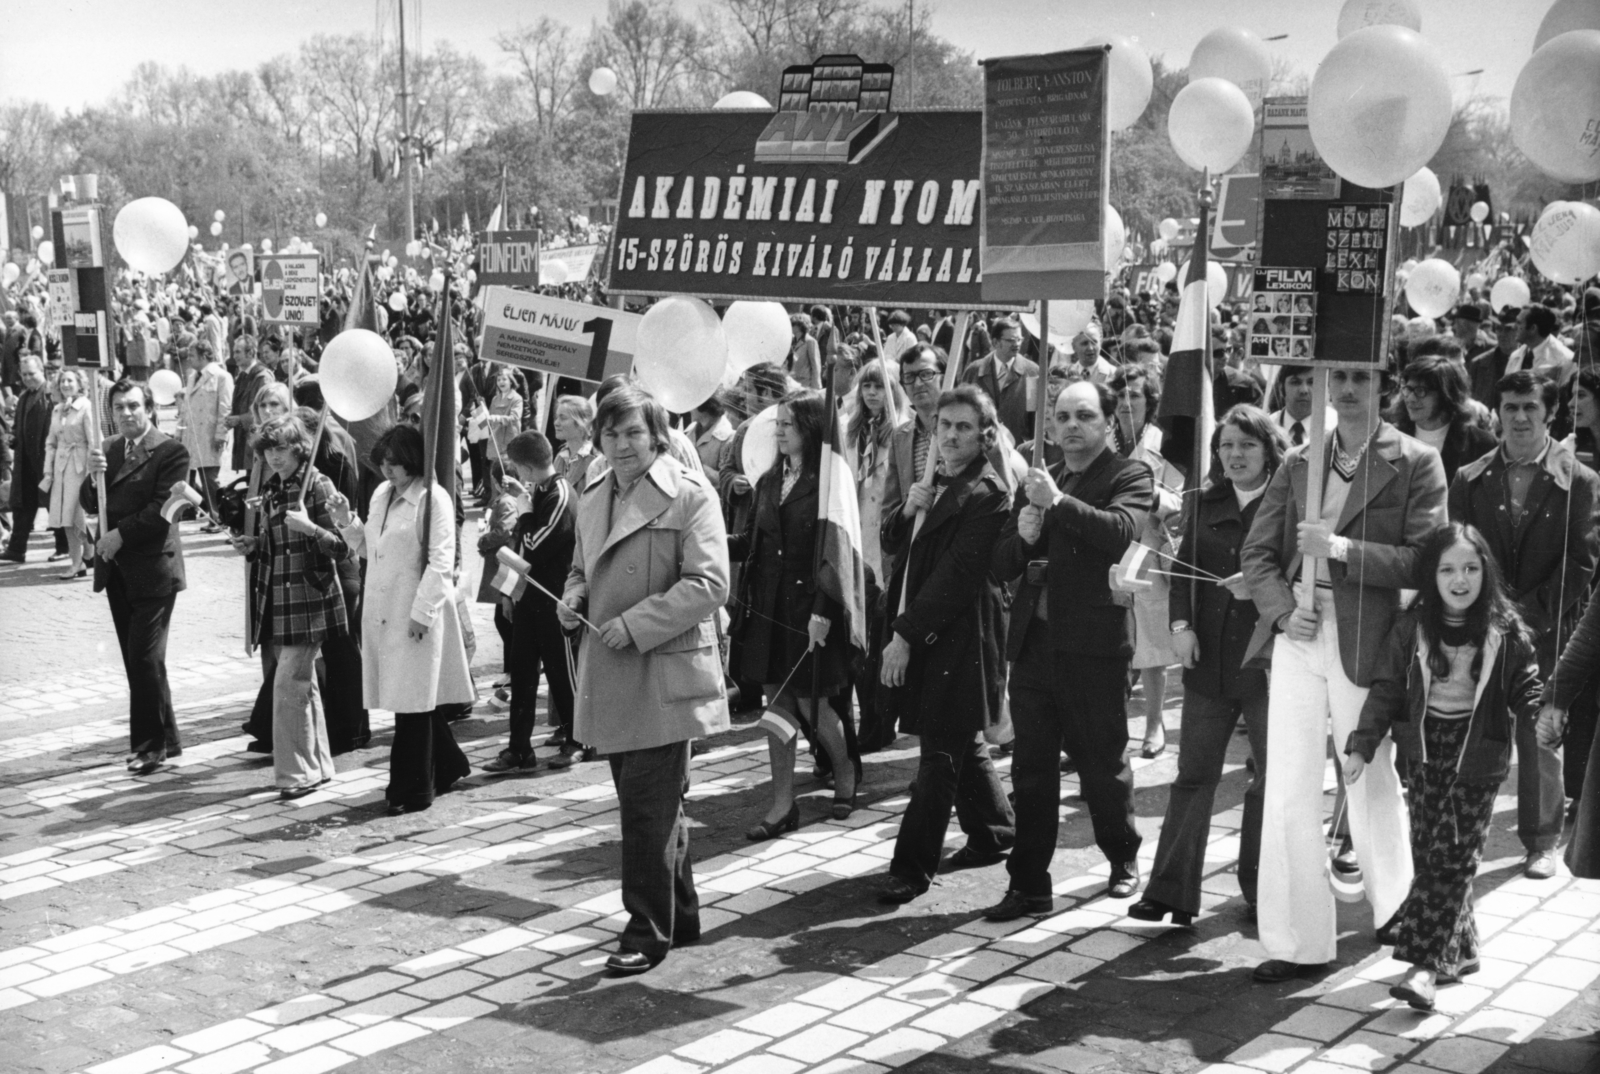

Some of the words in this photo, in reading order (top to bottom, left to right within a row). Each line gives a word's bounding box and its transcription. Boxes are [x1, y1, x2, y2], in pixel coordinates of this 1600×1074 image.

[756, 111, 881, 142] ANY
[628, 164, 838, 223] AKADÉMIAI
[858, 179, 980, 225] NYOM
[618, 233, 744, 274] 15-SZÖRÖS
[752, 235, 854, 280] KIVÁLÓ
[864, 238, 982, 283] VÁLLAL
[1266, 270, 1312, 282] FILM
[1338, 272, 1378, 290] KON
[1266, 282, 1312, 290] LEXIKON
[497, 341, 546, 356] NEMZETKÖZI
[503, 304, 538, 324] ÉLJEN
[540, 313, 580, 332] MÁJUS
[582, 316, 614, 382] 1
[507, 334, 578, 354] MUNKÁSOSZTÁLY
[496, 349, 560, 368] SEREGSZEMLÉJE!
